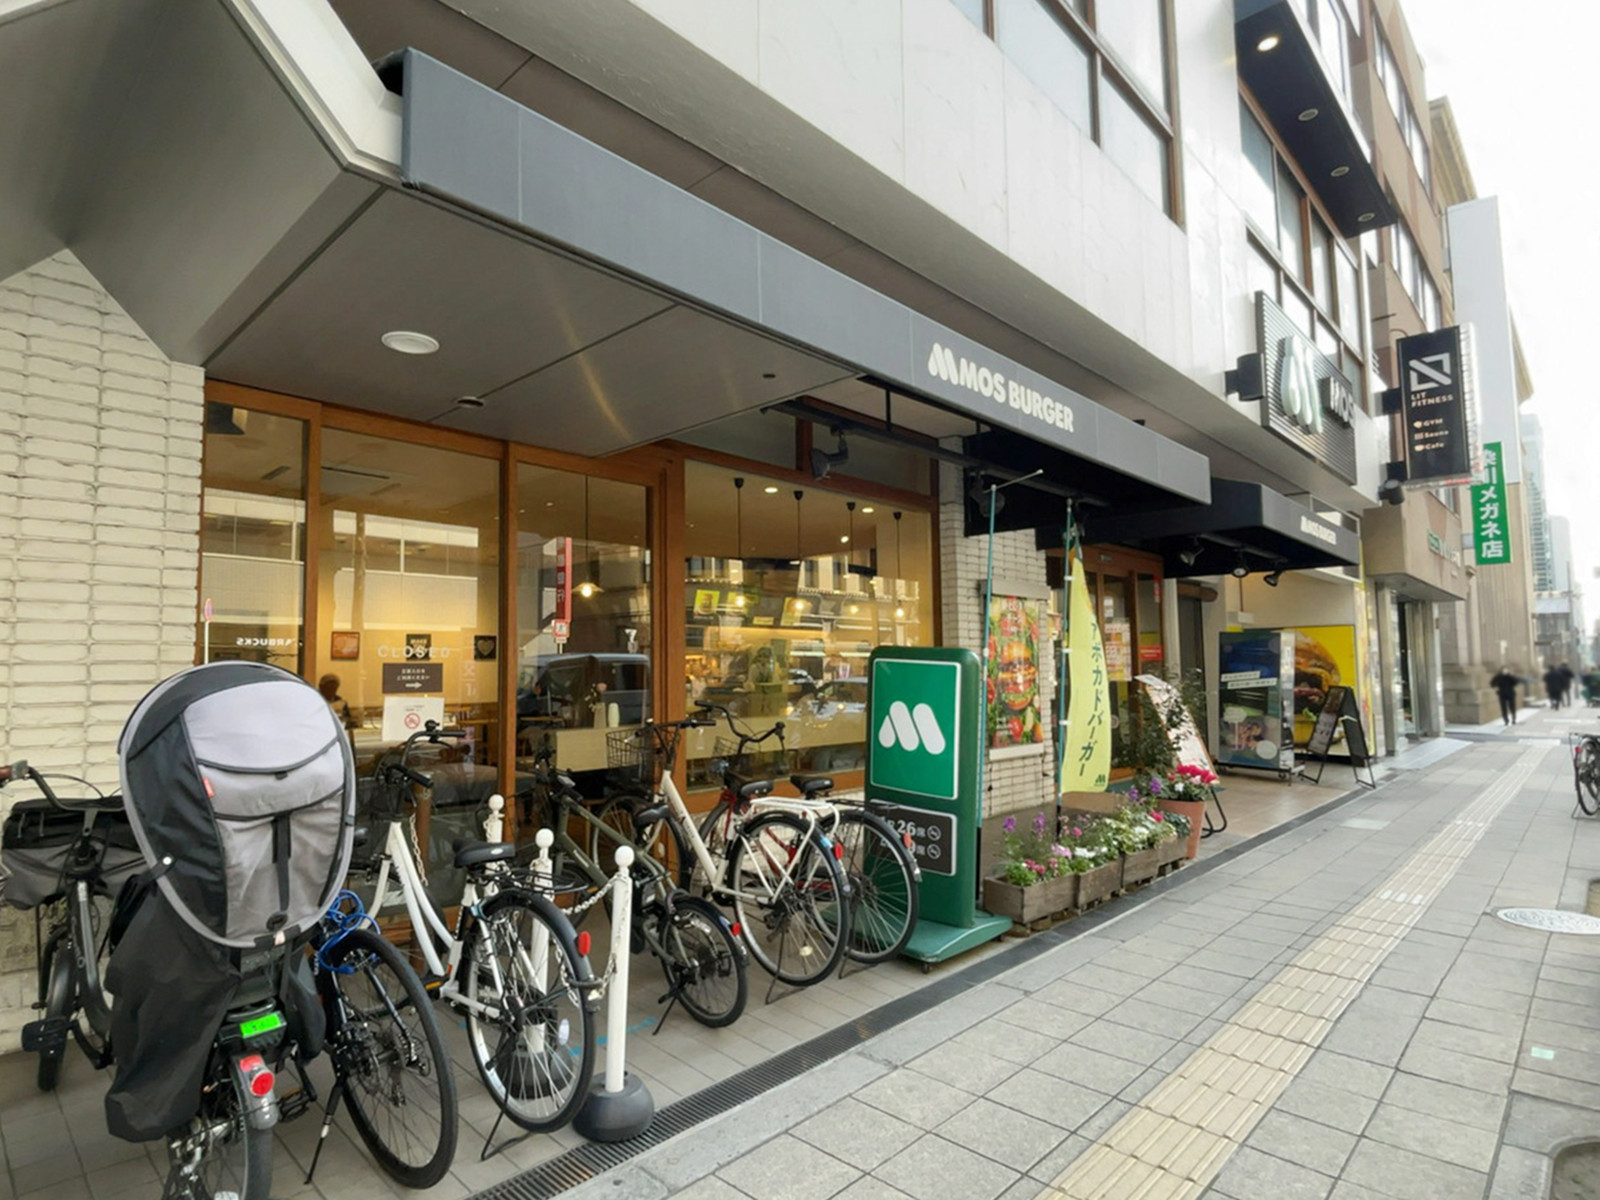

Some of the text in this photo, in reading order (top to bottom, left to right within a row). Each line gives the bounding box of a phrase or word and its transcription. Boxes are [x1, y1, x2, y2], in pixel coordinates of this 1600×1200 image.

[959, 357, 1075, 433] MOS BURGER
[1411, 391, 1427, 401] LIT
[1411, 394, 1454, 408] FITNESS
[1423, 418, 1444, 427] GYM
[1425, 442, 1445, 451] Cafe
